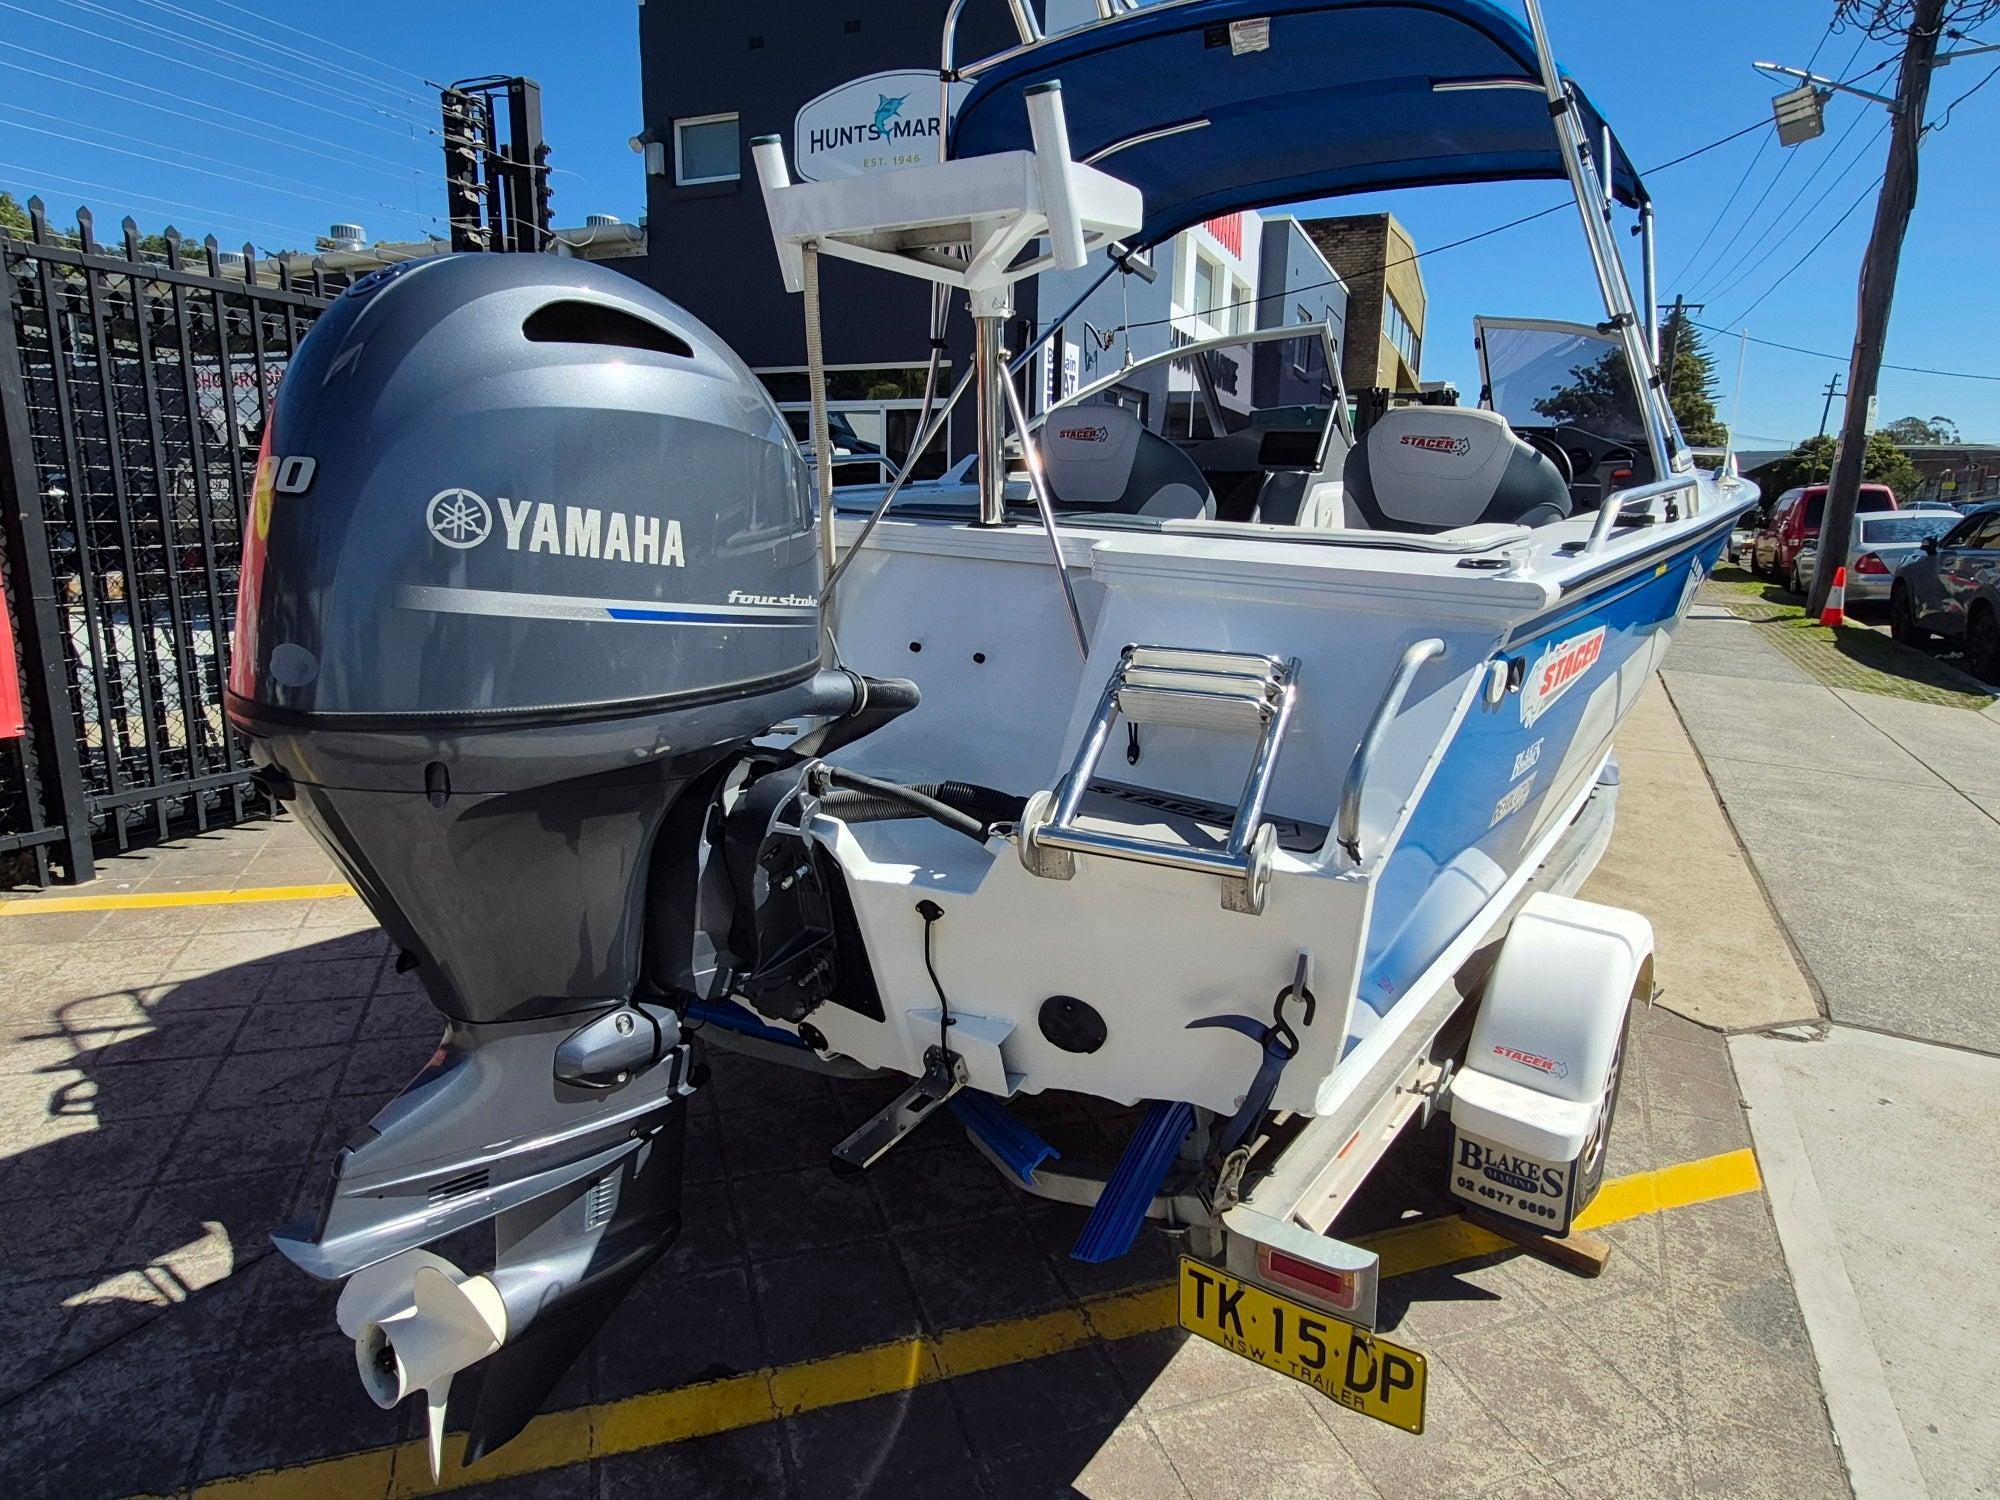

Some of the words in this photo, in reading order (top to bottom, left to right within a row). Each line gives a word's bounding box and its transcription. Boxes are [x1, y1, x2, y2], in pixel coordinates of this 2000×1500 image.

[810, 124, 880, 154] HUNTS
[894, 115, 955, 138] MAR
[863, 157, 888, 168] EST.
[893, 154, 920, 165] 1946
[1060, 430, 1096, 438] STACER
[1400, 436, 1455, 449] STACER
[497, 497, 685, 568] YAMAHA
[1539, 633, 1603, 696] STACER
[1493, 1046, 1554, 1070] STACER
[1457, 1138, 1563, 1198] BLAKES
[1457, 1176, 1474, 1192] 02
[1478, 1184, 1514, 1206] 4577
[1223, 1334, 1266, 1361] NSW
[1288, 1362, 1366, 1412] TRAILER
